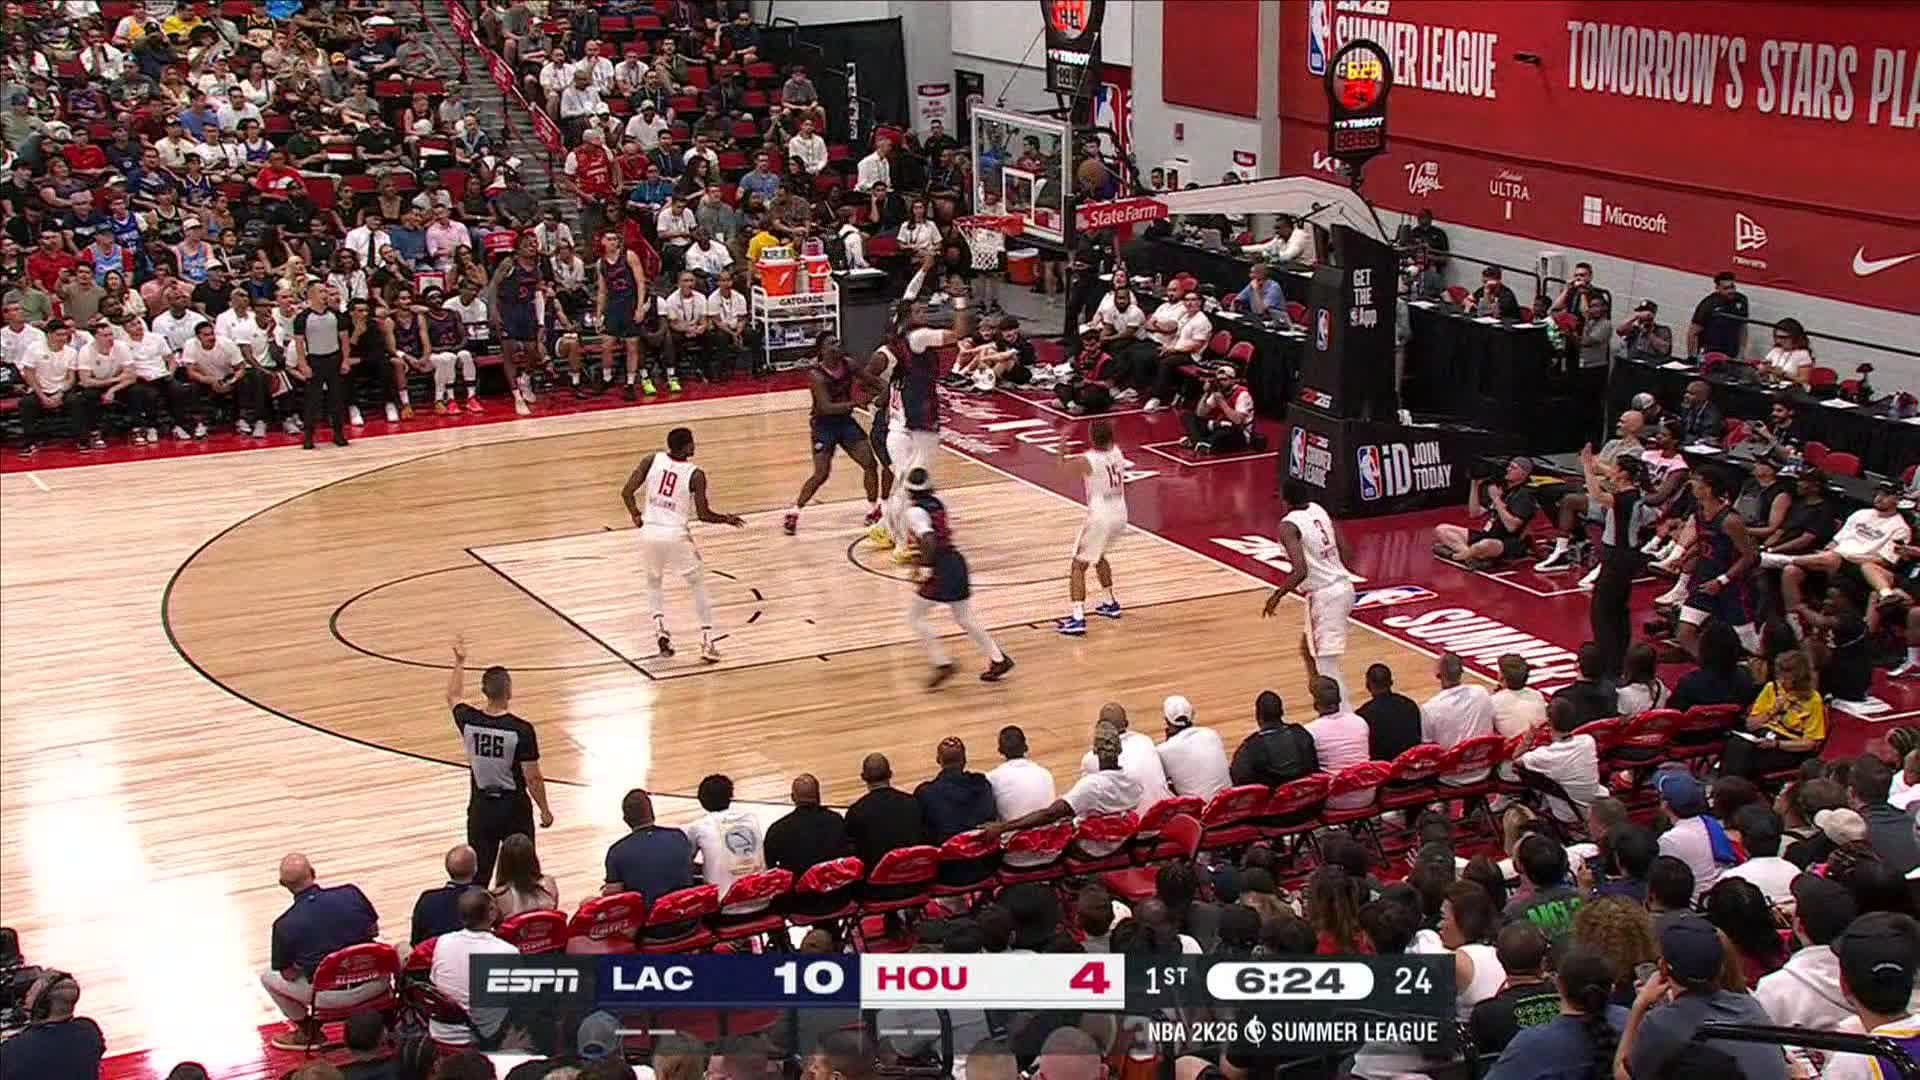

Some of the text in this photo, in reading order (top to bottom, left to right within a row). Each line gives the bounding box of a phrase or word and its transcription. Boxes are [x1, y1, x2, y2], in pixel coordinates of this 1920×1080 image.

[1422, 25, 1498, 98] LEAGUE
[1567, 20, 1747, 109] TOMORROW'S
[1757, 39, 1858, 122] STARS
[1489, 181, 1530, 200] ULTRA
[1604, 204, 1668, 234] Microsoft
[1353, 268, 1372, 287] GET
[1353, 287, 1373, 306] THE
[1411, 441, 1441, 466] JOIN
[658, 469, 678, 497] 19
[1412, 464, 1452, 492] TODAY
[1314, 519, 1330, 546] 3
[473, 732, 505, 759] 126
